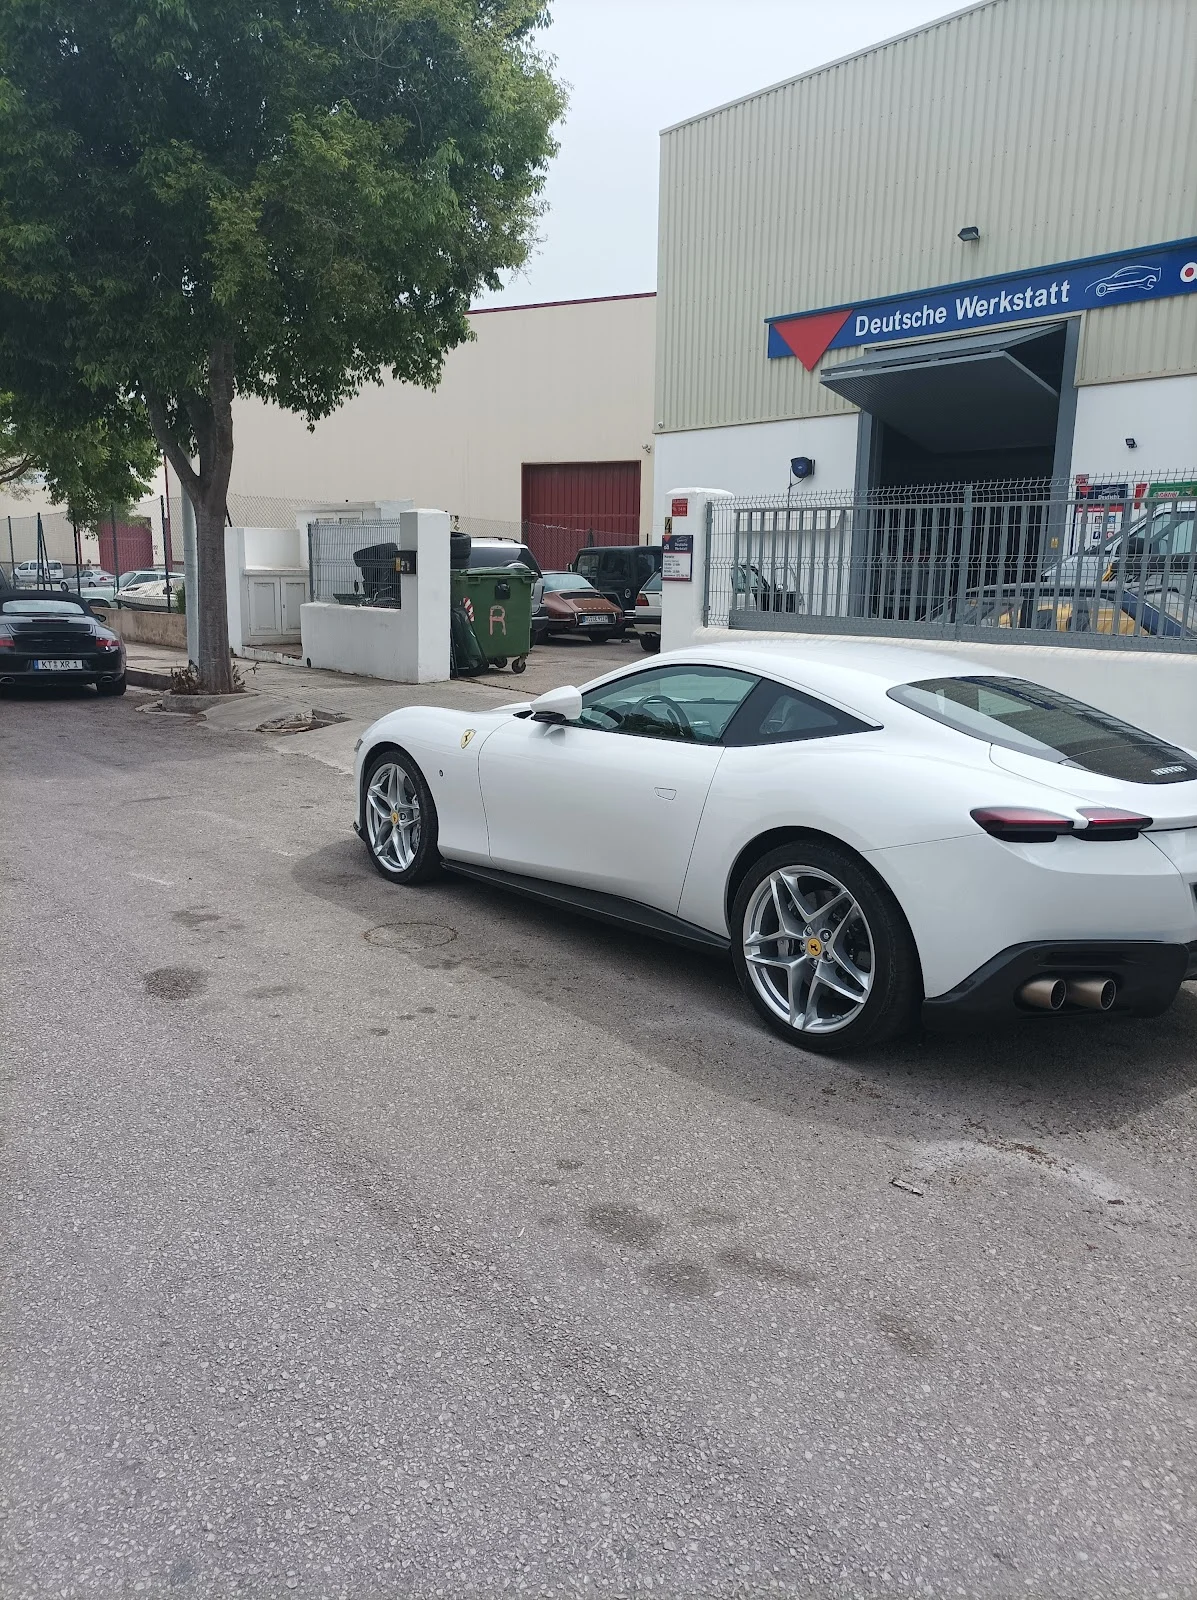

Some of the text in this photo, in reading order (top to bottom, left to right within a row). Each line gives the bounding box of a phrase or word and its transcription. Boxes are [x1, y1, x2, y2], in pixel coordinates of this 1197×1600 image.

[855, 280, 1070, 337] Deutsche Werkstatt
[665, 518, 672, 533] 4
[490, 605, 506, 635] R
[41, 660, 52, 669] KT
[59, 660, 71, 669] XR
